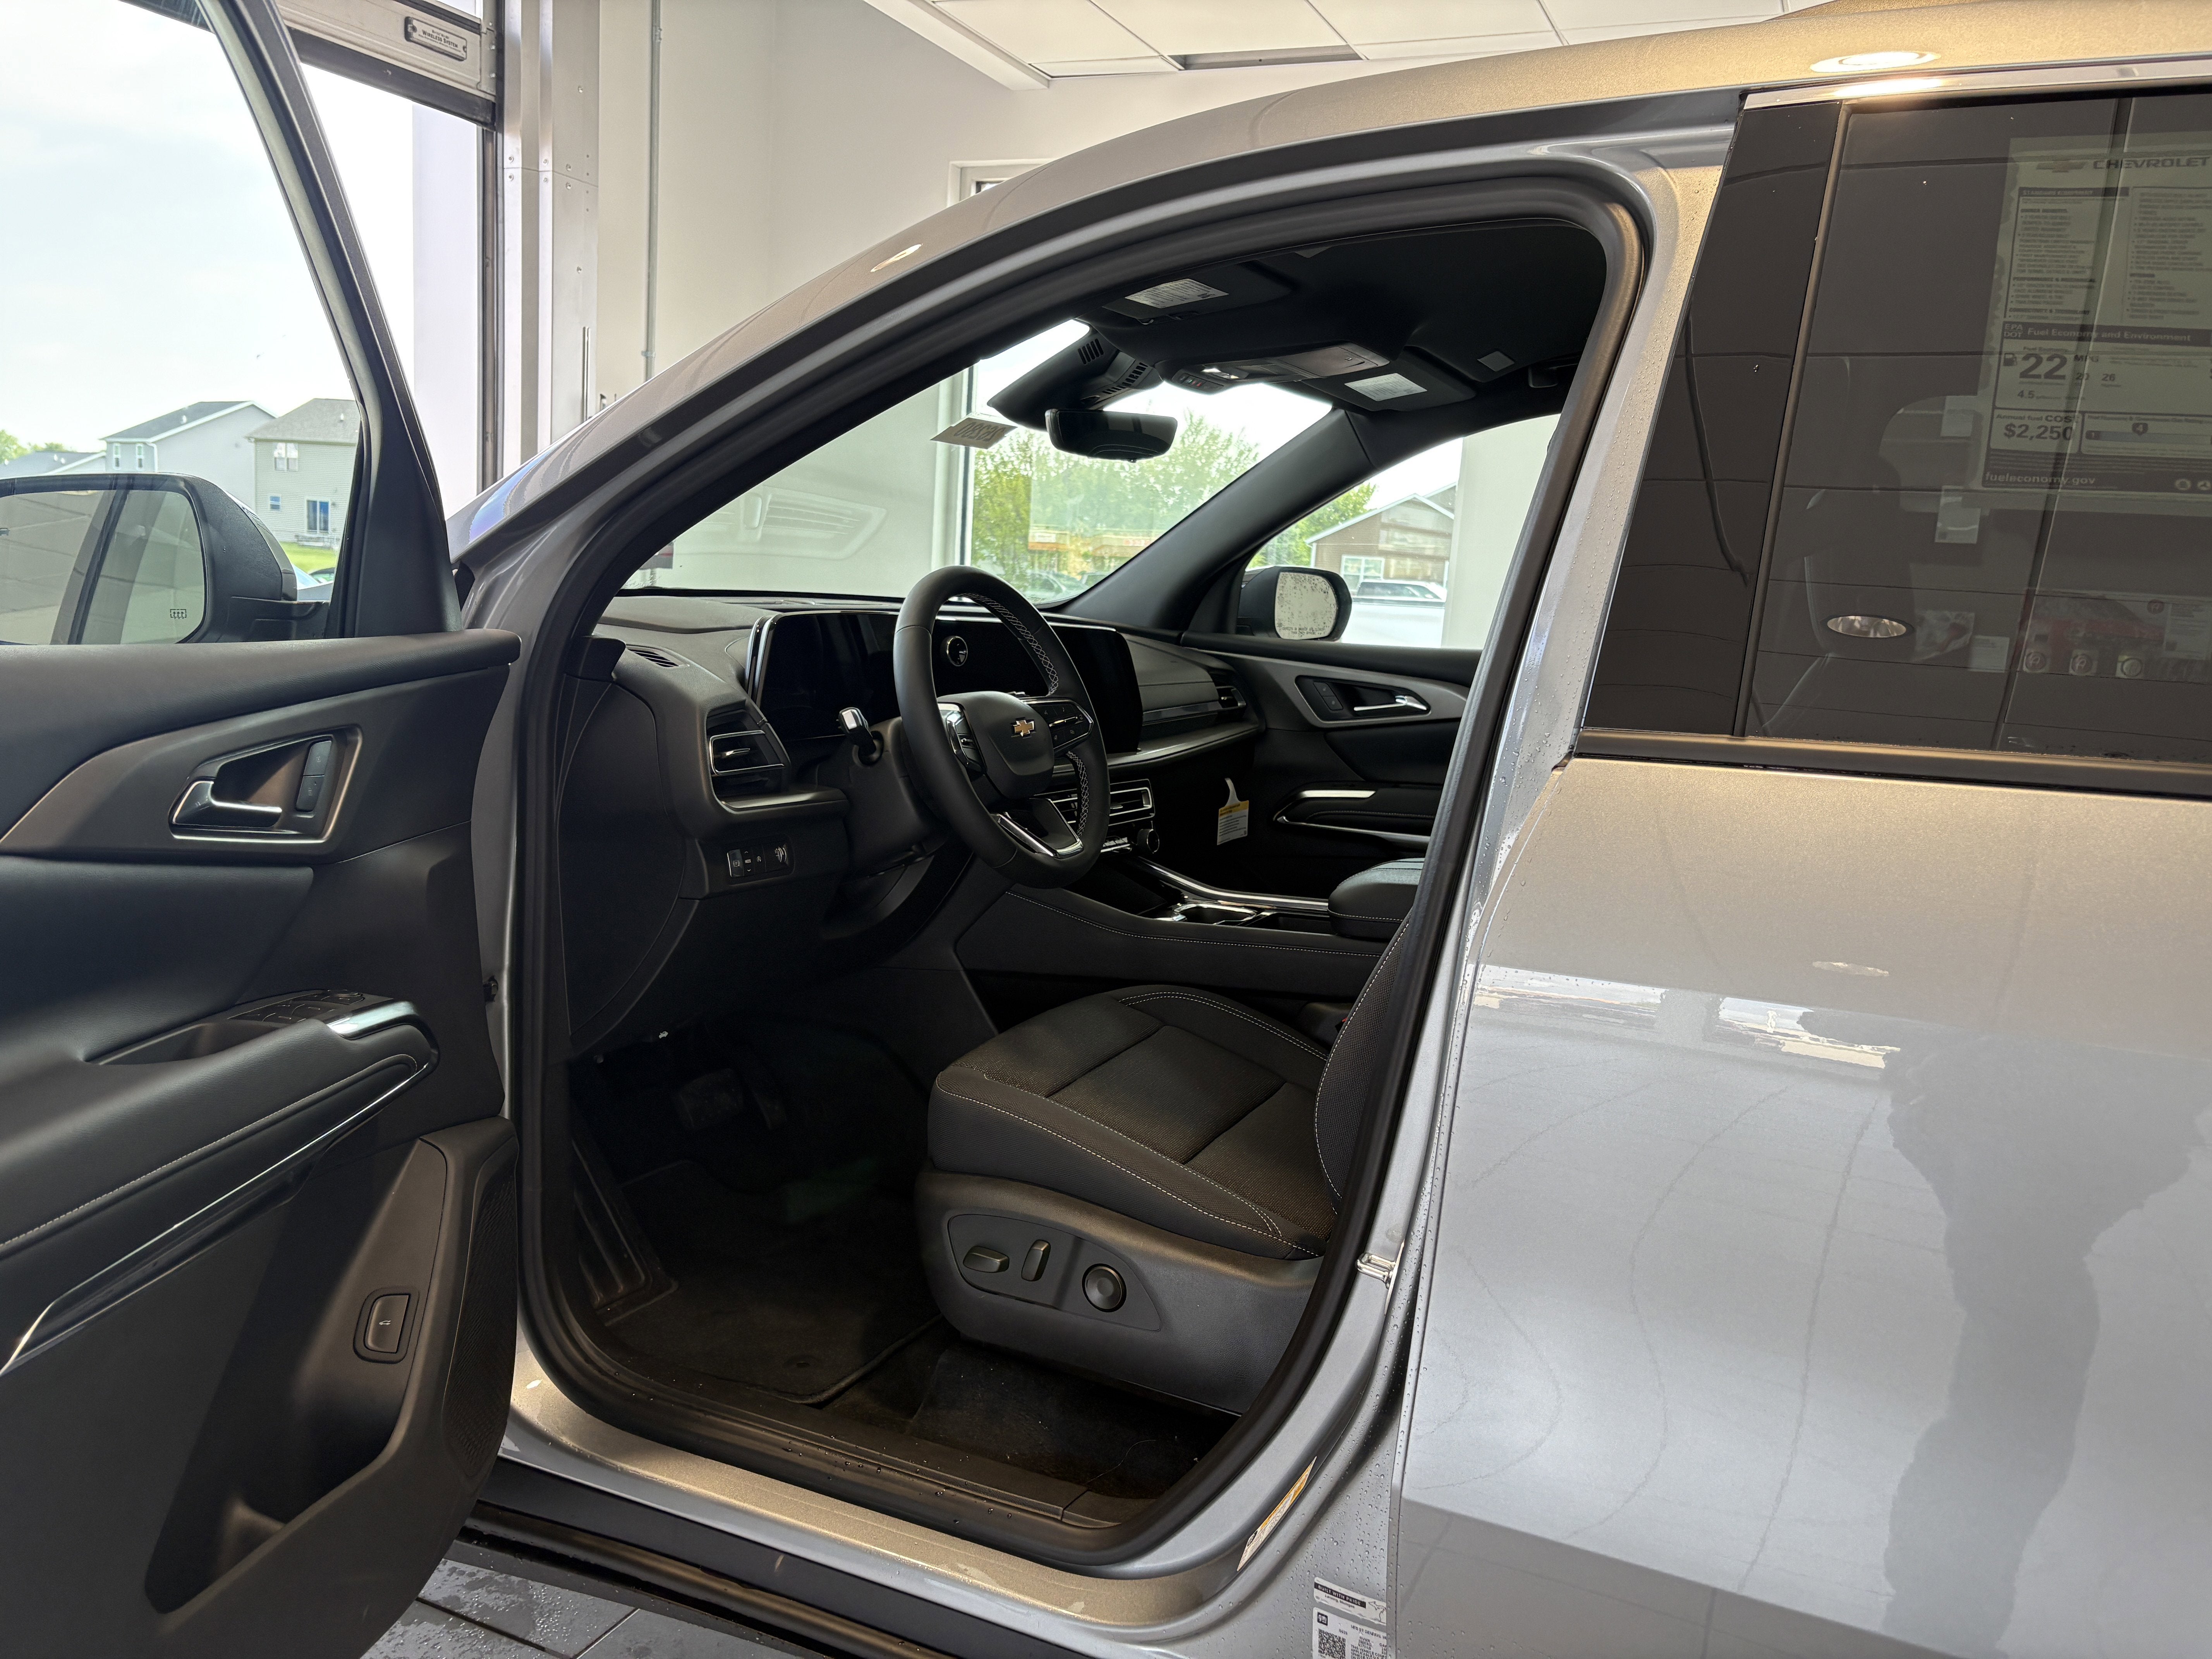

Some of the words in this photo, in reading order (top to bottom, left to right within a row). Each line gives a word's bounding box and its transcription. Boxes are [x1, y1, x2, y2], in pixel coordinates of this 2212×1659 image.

[2093, 156, 2210, 169] CHEVROLET
[2028, 328, 2049, 336] Fuel
[2052, 328, 2097, 339] Economy
[2124, 331, 2191, 342] Environment
[2019, 353, 2067, 380] 22
[2017, 390, 2035, 398] 4.5
[2004, 423, 2073, 441] $2,250
[1985, 471, 2095, 485] fueleconomy.gov
[1318, 1585, 1331, 1594] BUILT
[1332, 1590, 1345, 1599] WITH
[1346, 1596, 1361, 1606] PRIDE
[1318, 1614, 1327, 1623] gm
